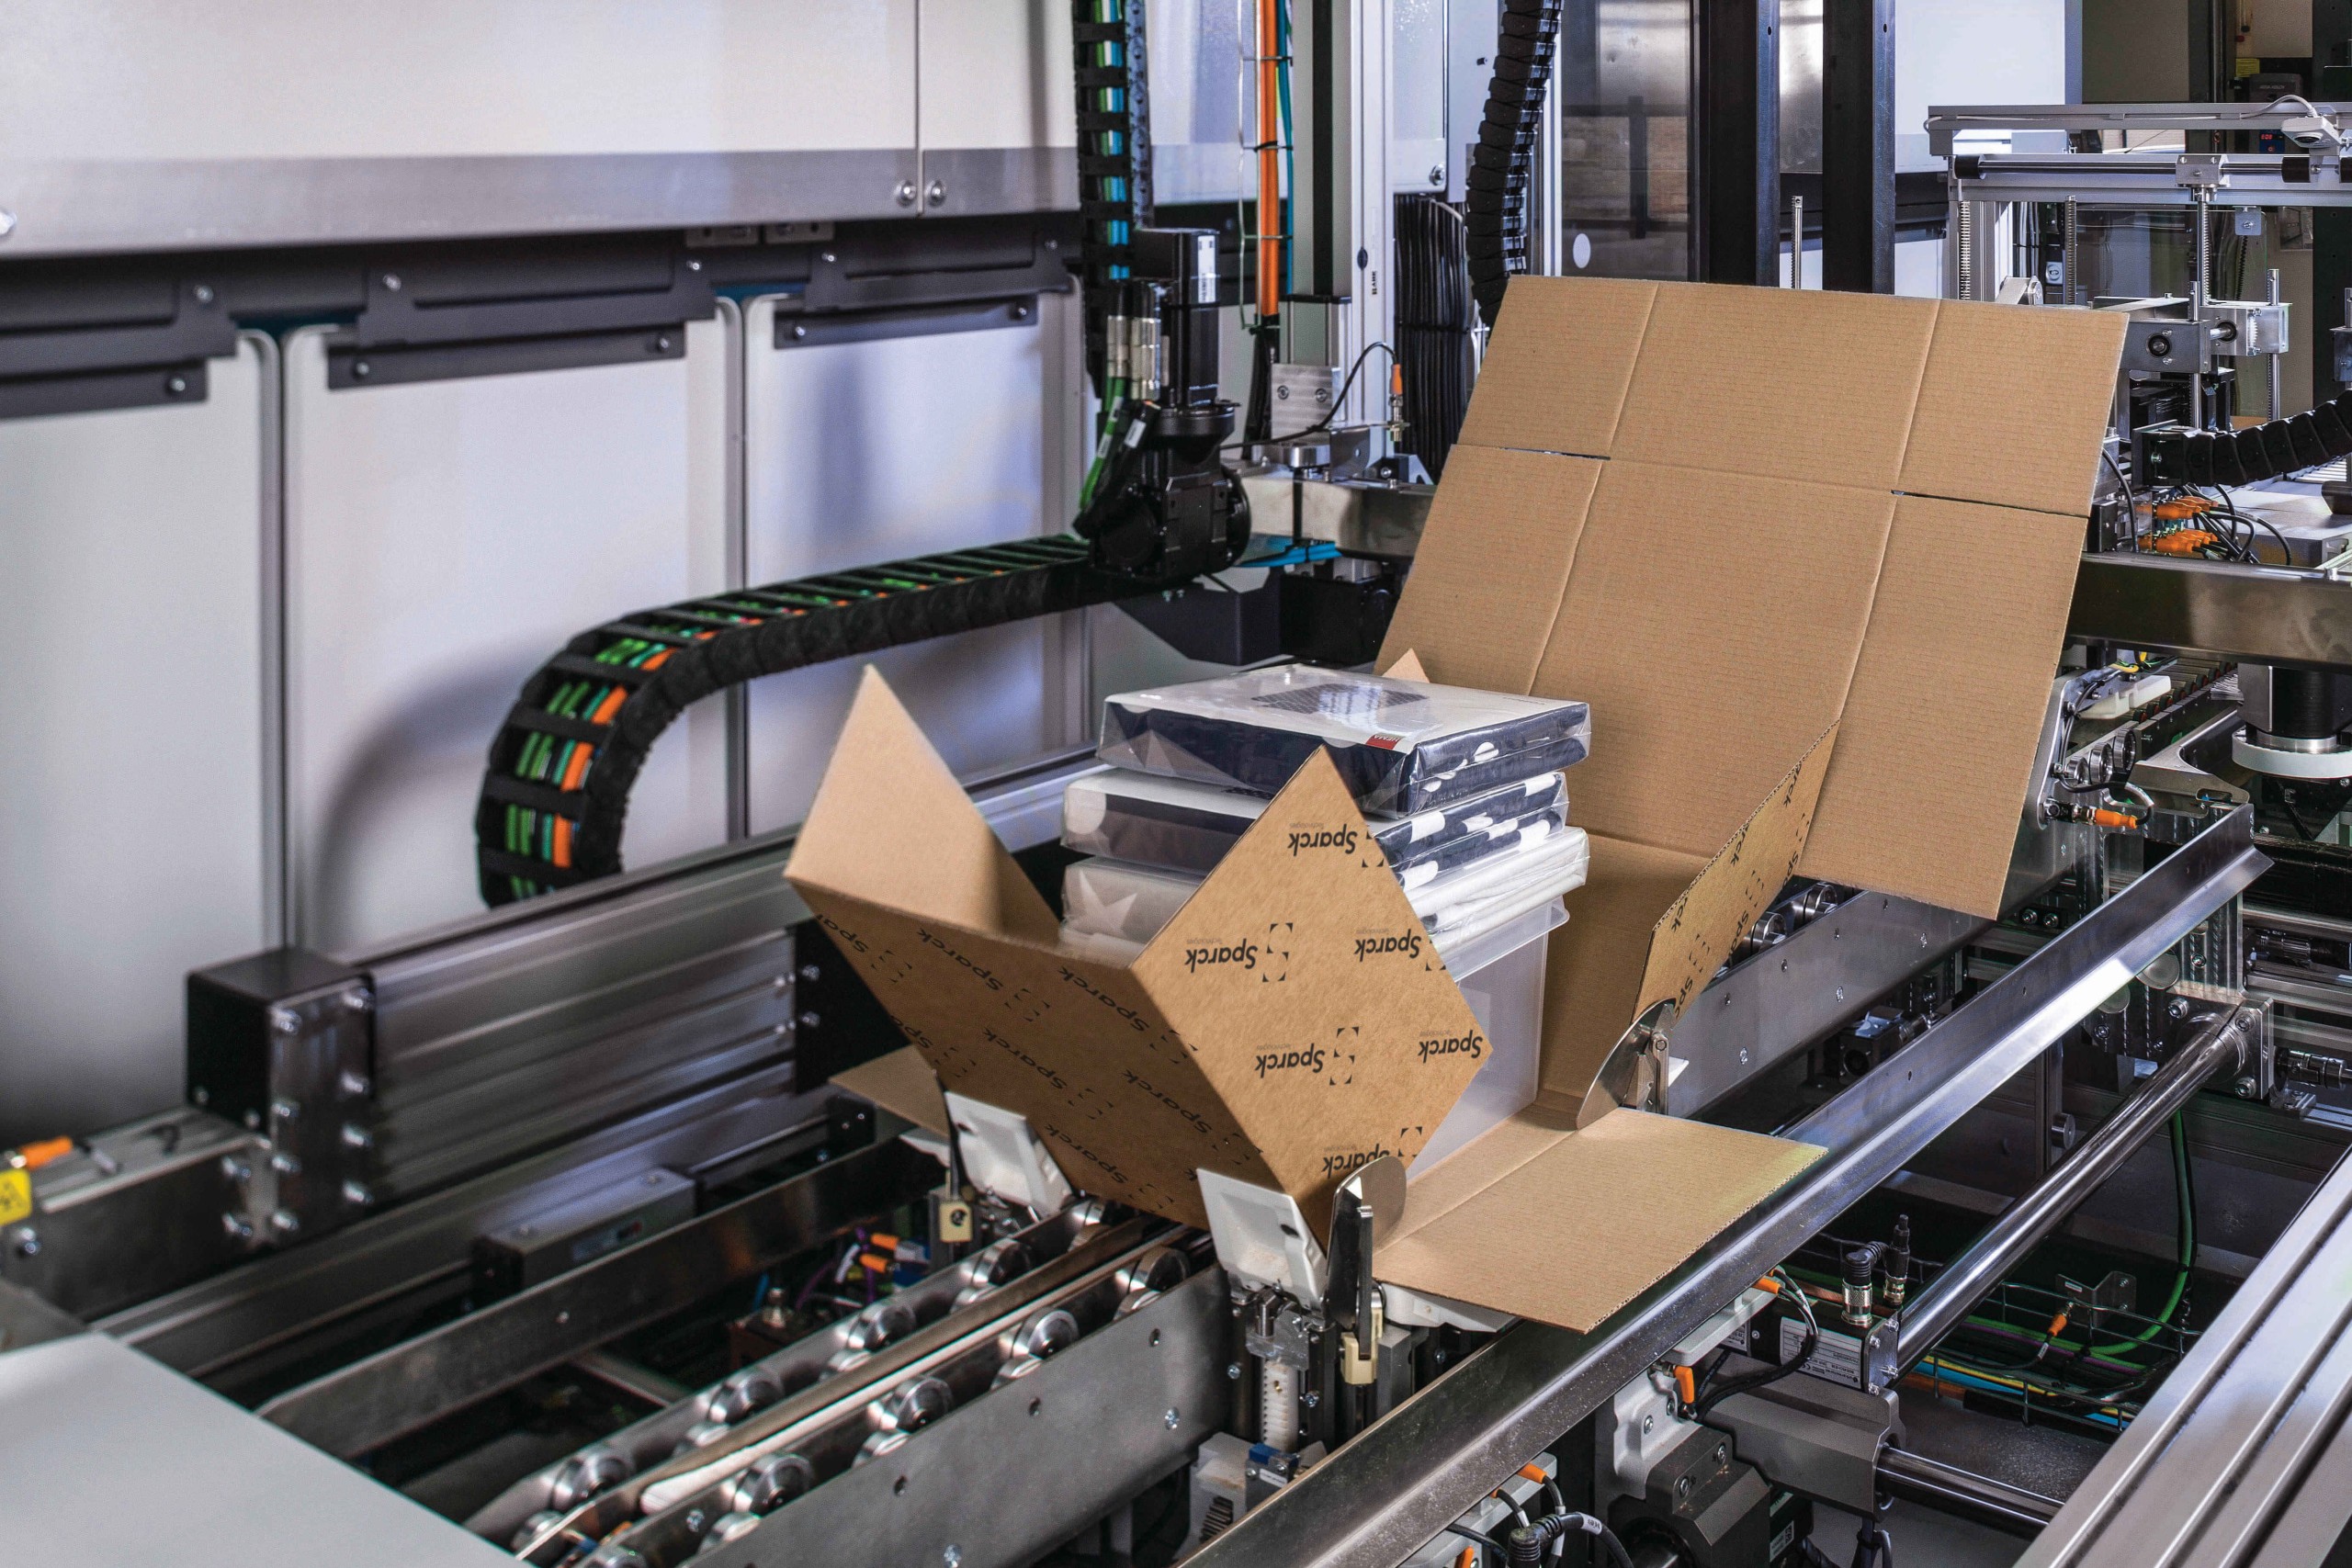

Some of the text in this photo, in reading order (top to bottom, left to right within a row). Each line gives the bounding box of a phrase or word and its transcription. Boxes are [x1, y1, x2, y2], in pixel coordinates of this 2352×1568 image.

[1287, 824, 1358, 856] Sparck
[916, 928, 1004, 992] Sparck
[1184, 938, 1259, 974] Sparck
[1353, 929, 1422, 962] Sparck
[1058, 967, 1150, 1032] Sparck
[981, 1027, 1069, 1090] Sparck
[1255, 1043, 1326, 1078] Sparck
[1418, 1030, 1484, 1063] Sparck
[1122, 1069, 1212, 1134] Sparck
[1045, 1122, 1129, 1185] Sparck
